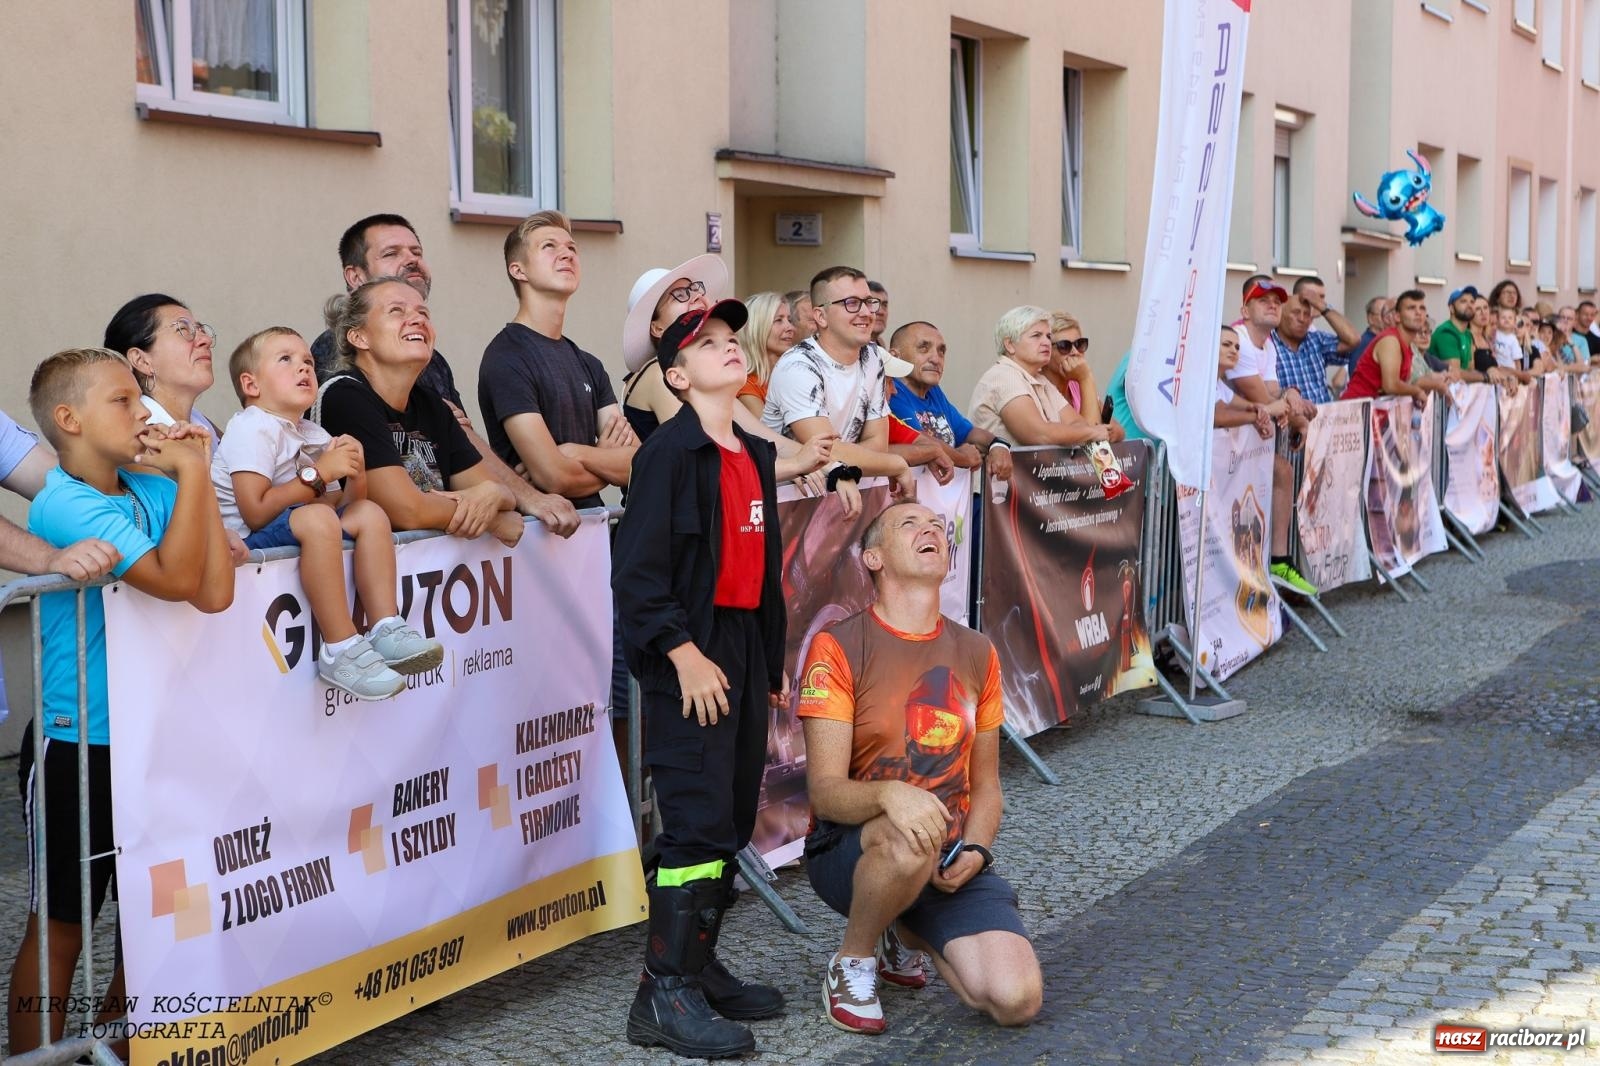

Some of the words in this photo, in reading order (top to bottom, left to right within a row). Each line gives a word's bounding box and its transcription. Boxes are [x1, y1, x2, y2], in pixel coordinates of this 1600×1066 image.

[711, 226, 719, 243] 2
[792, 221, 803, 237] 2
[262, 556, 513, 674] GTON
[1075, 611, 1110, 650] WRBA
[463, 647, 513, 677] reklama
[516, 702, 595, 755] KALENDARZE
[392, 766, 450, 818] BANERY
[516, 768, 522, 801] I
[525, 750, 582, 798] GADŻETY
[391, 832, 401, 867] I
[401, 813, 456, 863] SZYLDY
[520, 794, 581, 845] FIRMOWE
[213, 816, 272, 876] ODZIEŻ
[221, 891, 232, 931] Z
[234, 875, 284, 926] LOGO
[280, 856, 335, 908] FIRMY
[507, 880, 607, 941] www.gravton.pl
[354, 968, 383, 1001] +48
[384, 958, 409, 994] 781
[409, 947, 438, 982] 053
[438, 936, 465, 970] 997
